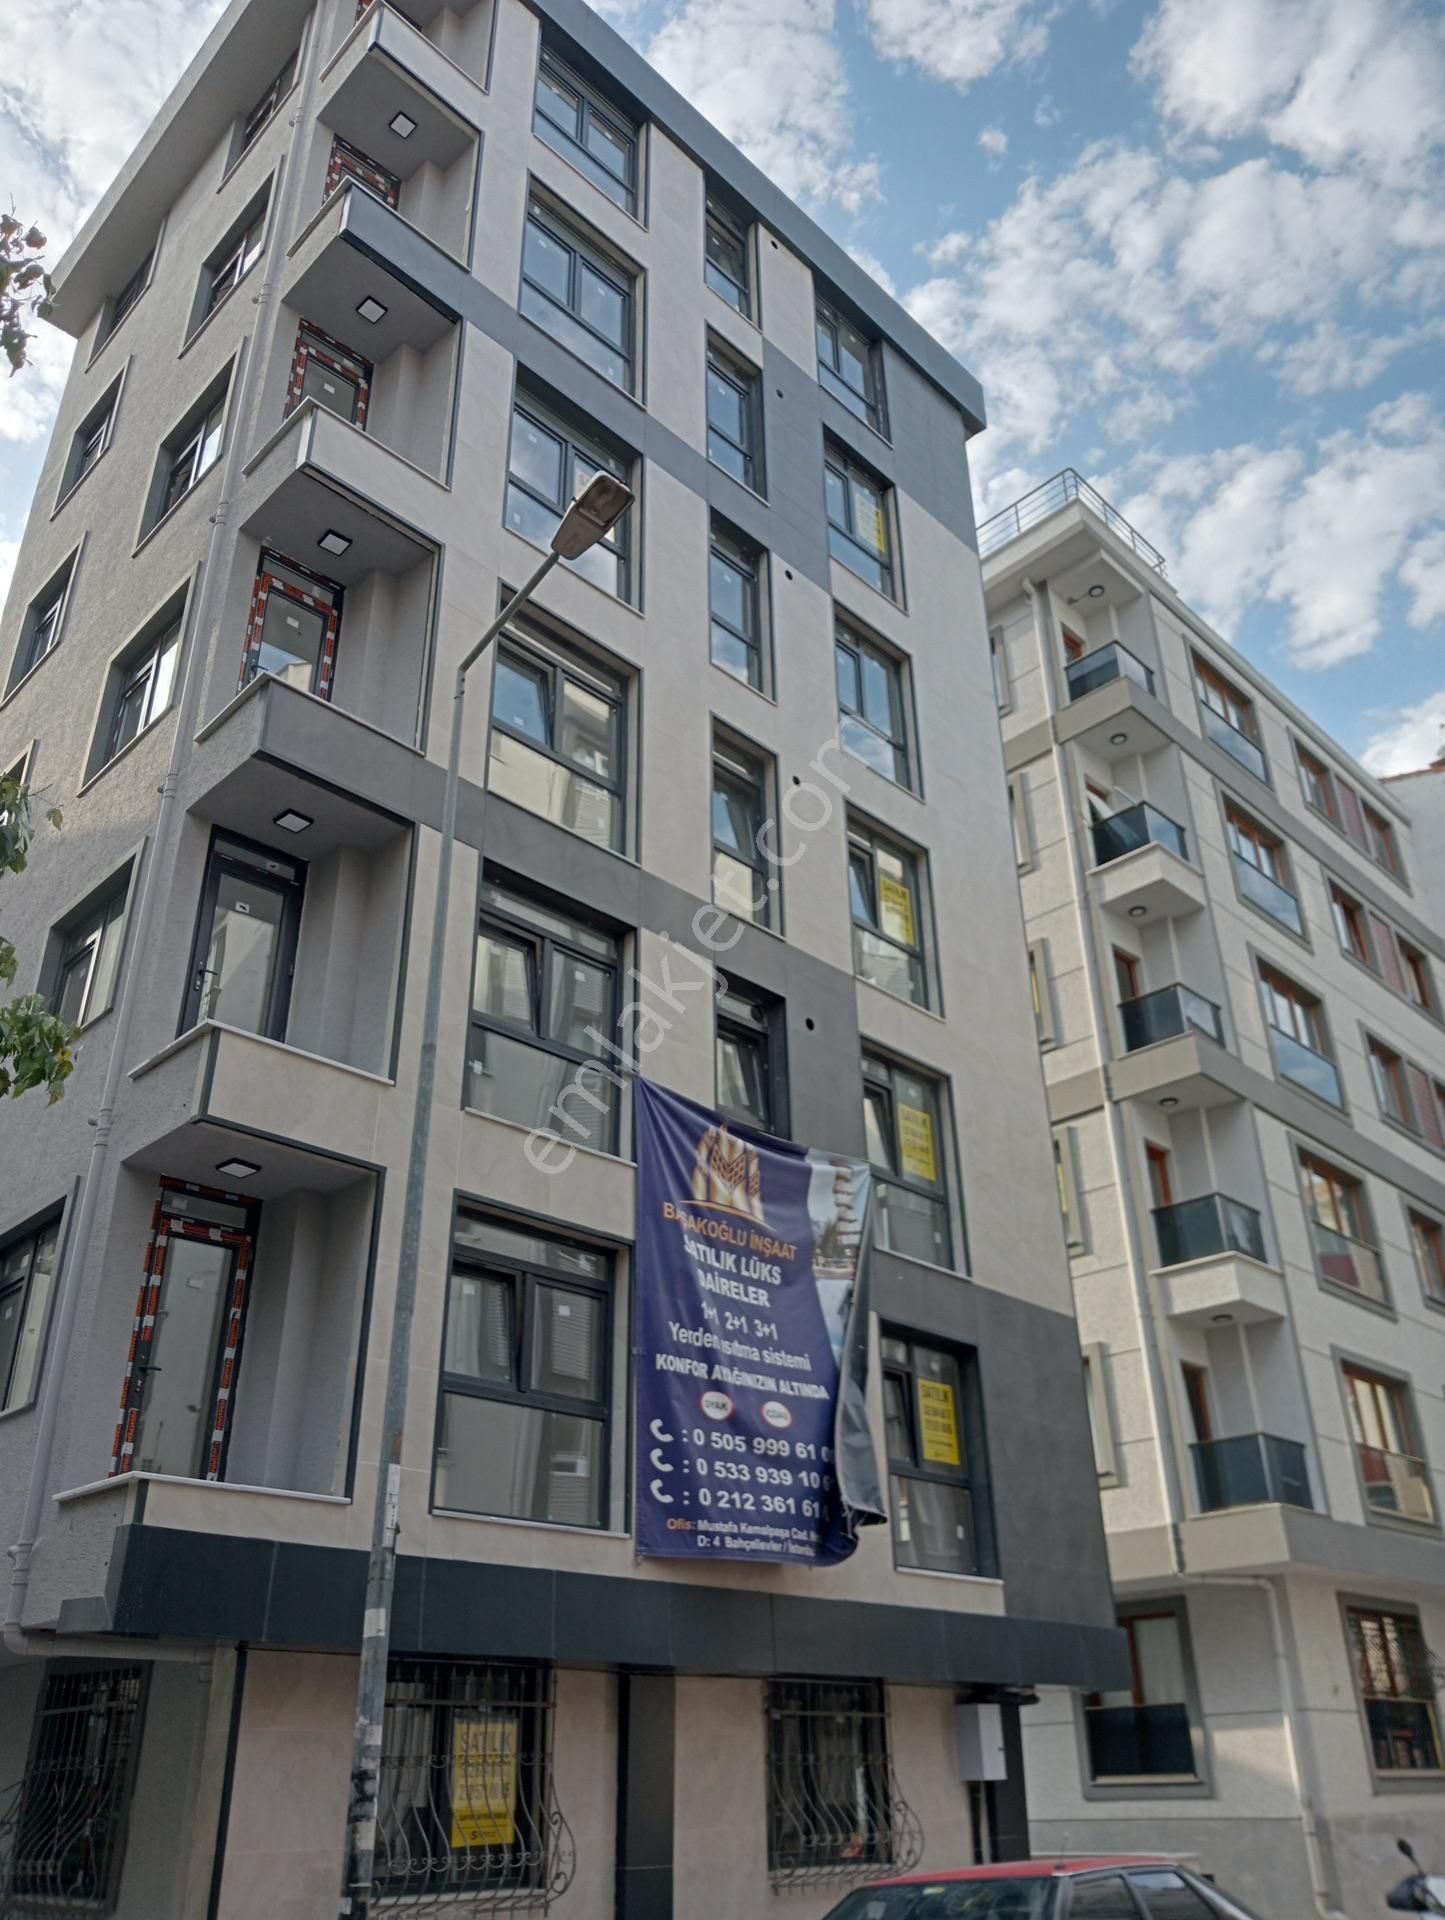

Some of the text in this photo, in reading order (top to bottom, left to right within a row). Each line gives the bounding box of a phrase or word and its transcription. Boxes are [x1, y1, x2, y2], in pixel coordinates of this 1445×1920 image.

[741, 1256, 782, 1285] LÜKS
[724, 1311, 748, 1334] 2+1
[754, 1319, 779, 1341] 3+1
[762, 1346, 812, 1372] sistemi
[655, 1353, 709, 1380] KONFOR
[779, 1379, 831, 1400] ALTINDA
[693, 1428, 705, 1446] 0
[711, 1432, 747, 1452] 505
[753, 1437, 790, 1456] 999
[795, 1442, 816, 1460] 61
[696, 1458, 708, 1475] 0
[714, 1461, 750, 1481] 533
[755, 1466, 793, 1486] 939
[798, 1471, 820, 1488] 10
[698, 1488, 711, 1506] 0
[716, 1490, 756, 1511] 212
[761, 1495, 796, 1514] 361
[802, 1499, 820, 1519] 61
[666, 1518, 696, 1531] Ofis:
[697, 1519, 738, 1533] Mustafa
[697, 1535, 711, 1547] D:
[713, 1535, 721, 1547] 4
